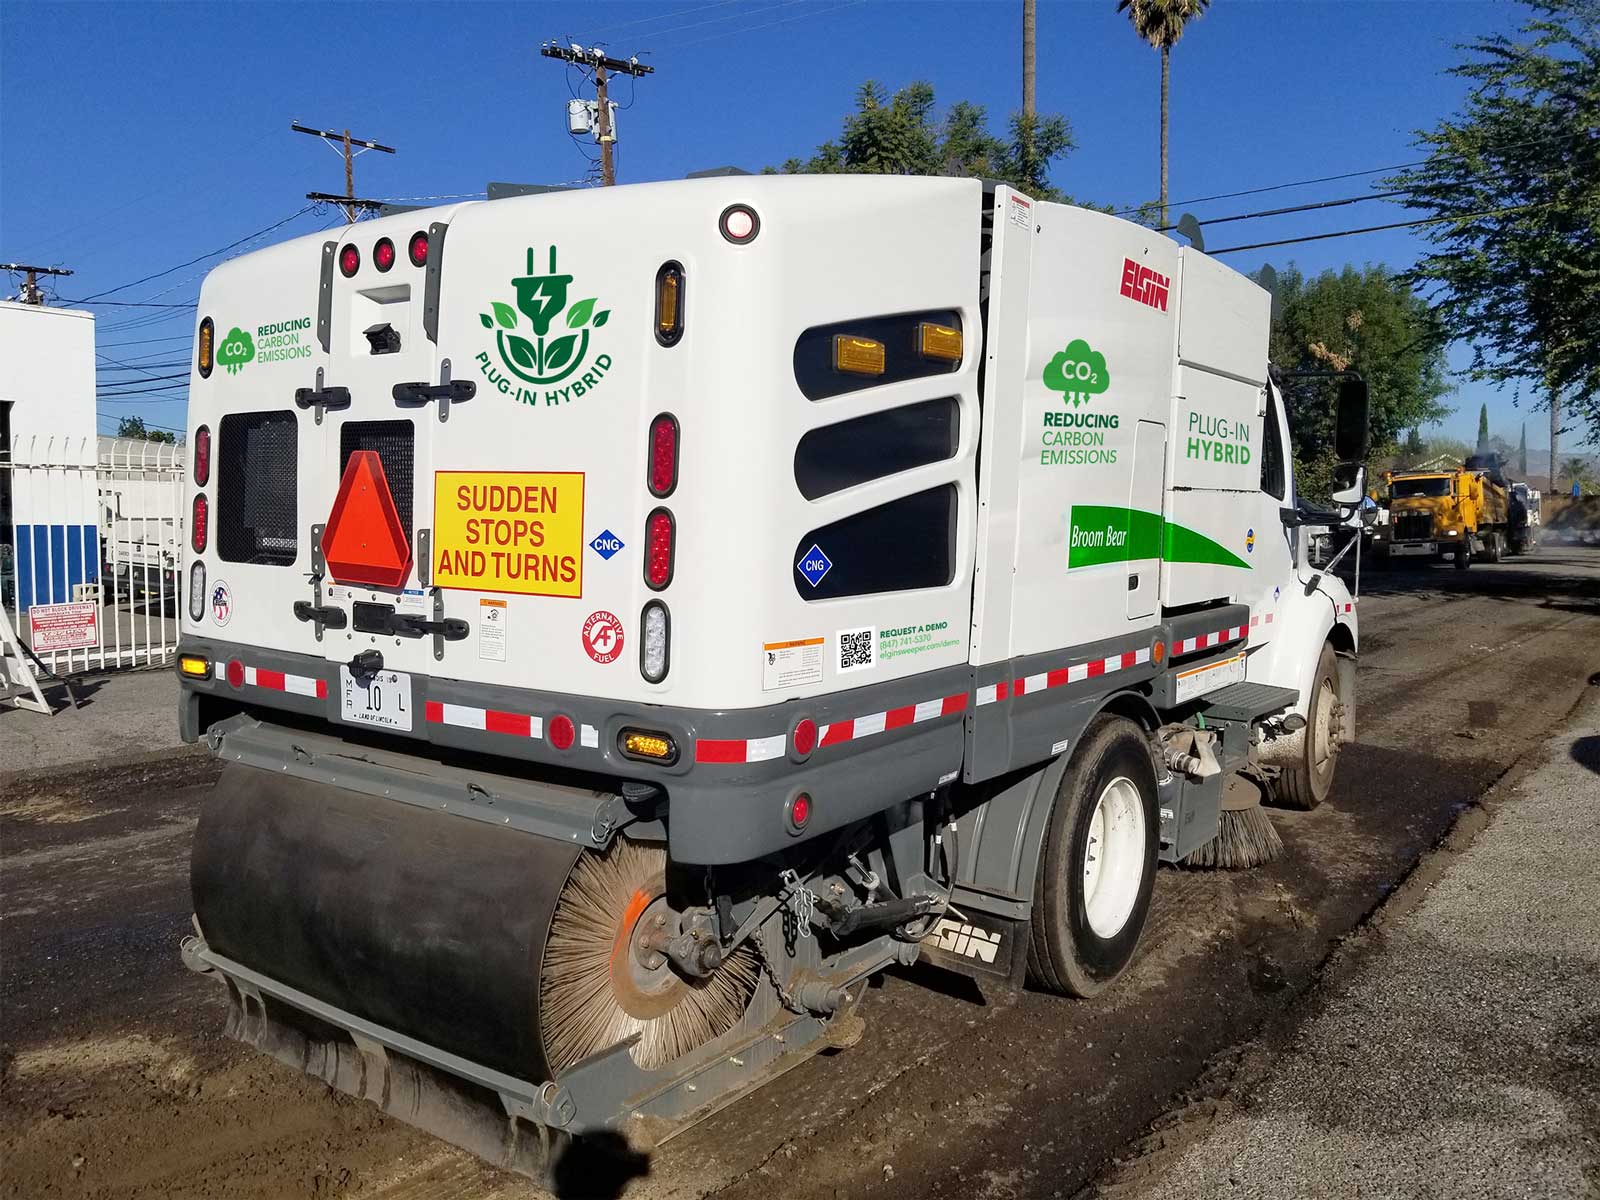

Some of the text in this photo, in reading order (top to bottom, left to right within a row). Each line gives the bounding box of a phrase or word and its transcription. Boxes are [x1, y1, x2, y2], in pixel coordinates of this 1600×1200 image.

[1120, 257, 1170, 312] ELGIN
[257, 317, 311, 337] REDUCING
[257, 333, 299, 350] CARBON
[257, 345, 312, 363] EMISSIONS
[475, 351, 613, 407] PLUG-IN HYBRID
[1043, 411, 1119, 429] REDUCING
[1188, 411, 1250, 442] PLUG-IN
[1041, 431, 1104, 446] CARBON
[1040, 449, 1117, 465] EMISSIONS
[1187, 437, 1251, 465] HYBRID
[456, 485, 558, 513] SUDDEN
[465, 518, 545, 547] STOPS
[1071, 524, 1127, 548] Broom Bear
[594, 539, 620, 551] CNG
[438, 550, 577, 583] AND TURNS
[805, 559, 824, 572] CNG
[583, 612, 624, 640] ALTERNATIVE
[880, 621, 948, 639] REQUEST A DEMO
[880, 633, 932, 651] (847) 741-5370
[880, 638, 960, 660] elginsweeper.com/demo
[594, 653, 615, 663] FUEL
[921, 918, 1001, 964] GIN
